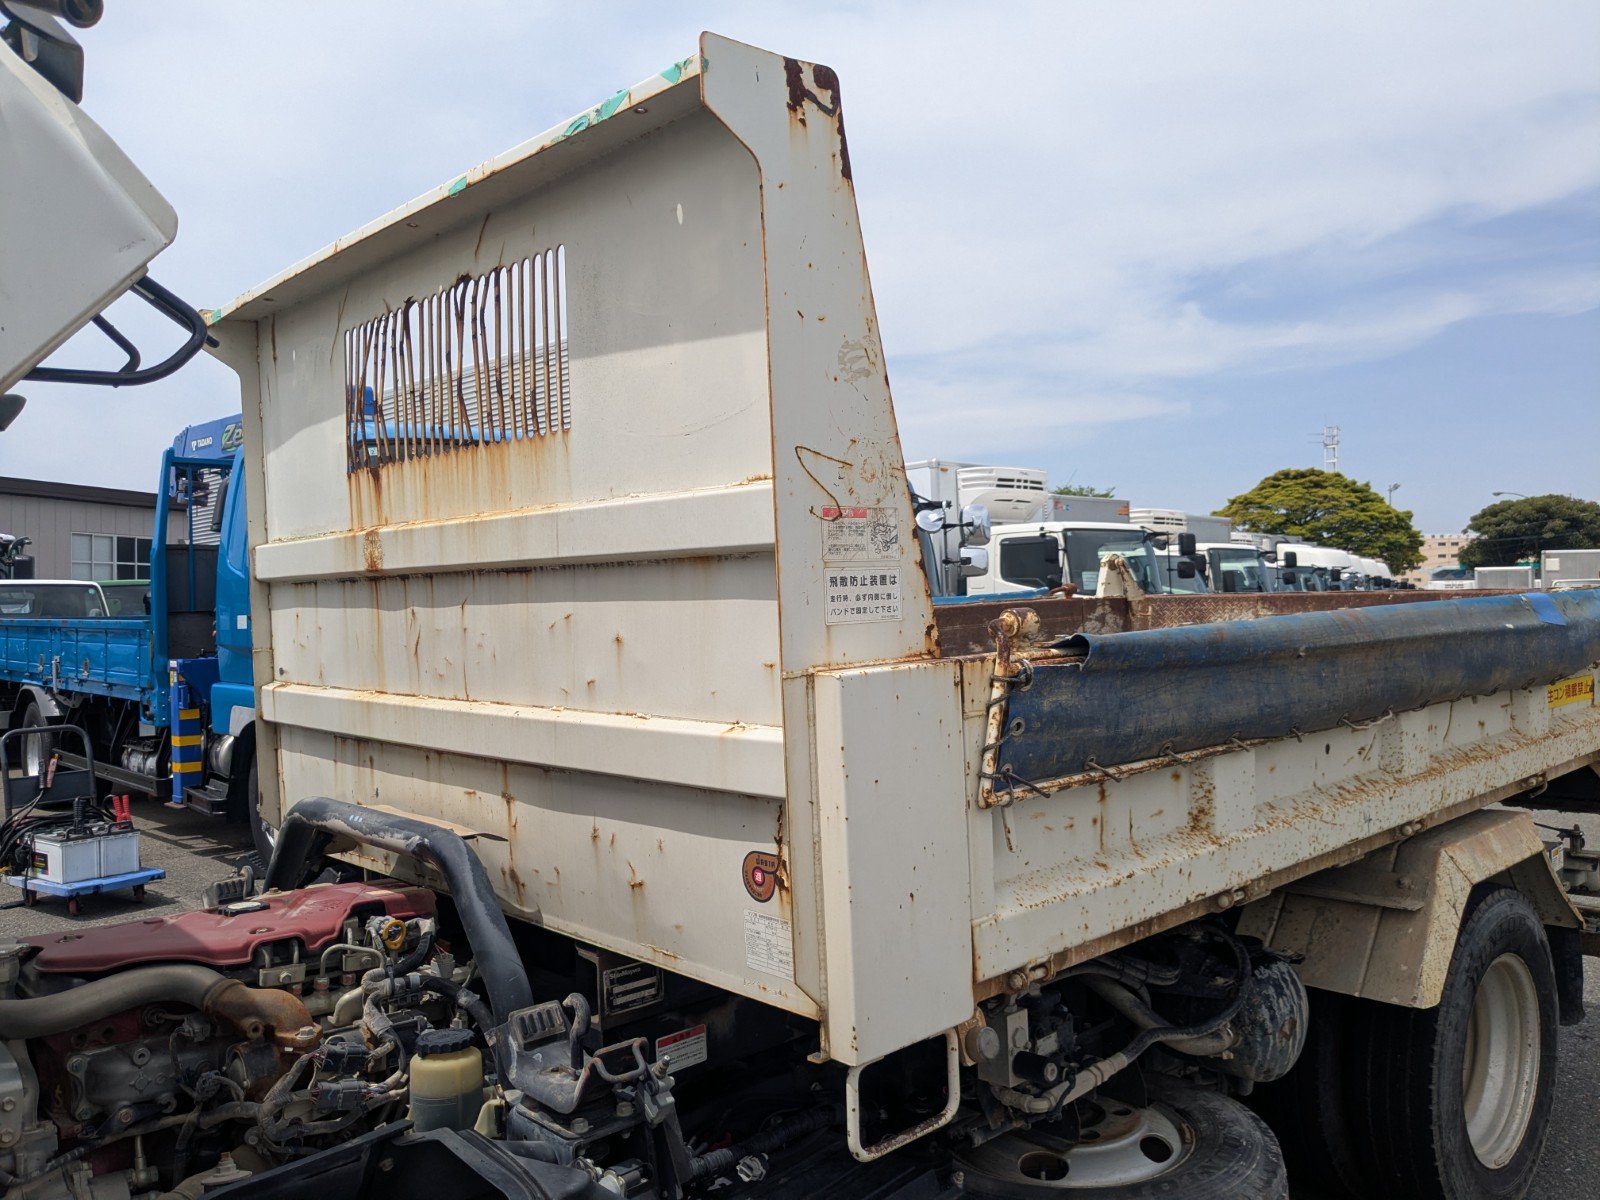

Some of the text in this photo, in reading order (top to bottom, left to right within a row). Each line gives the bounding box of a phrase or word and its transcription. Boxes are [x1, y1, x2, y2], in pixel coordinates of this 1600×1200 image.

[829, 574, 898, 588] 飛散防止装置は
